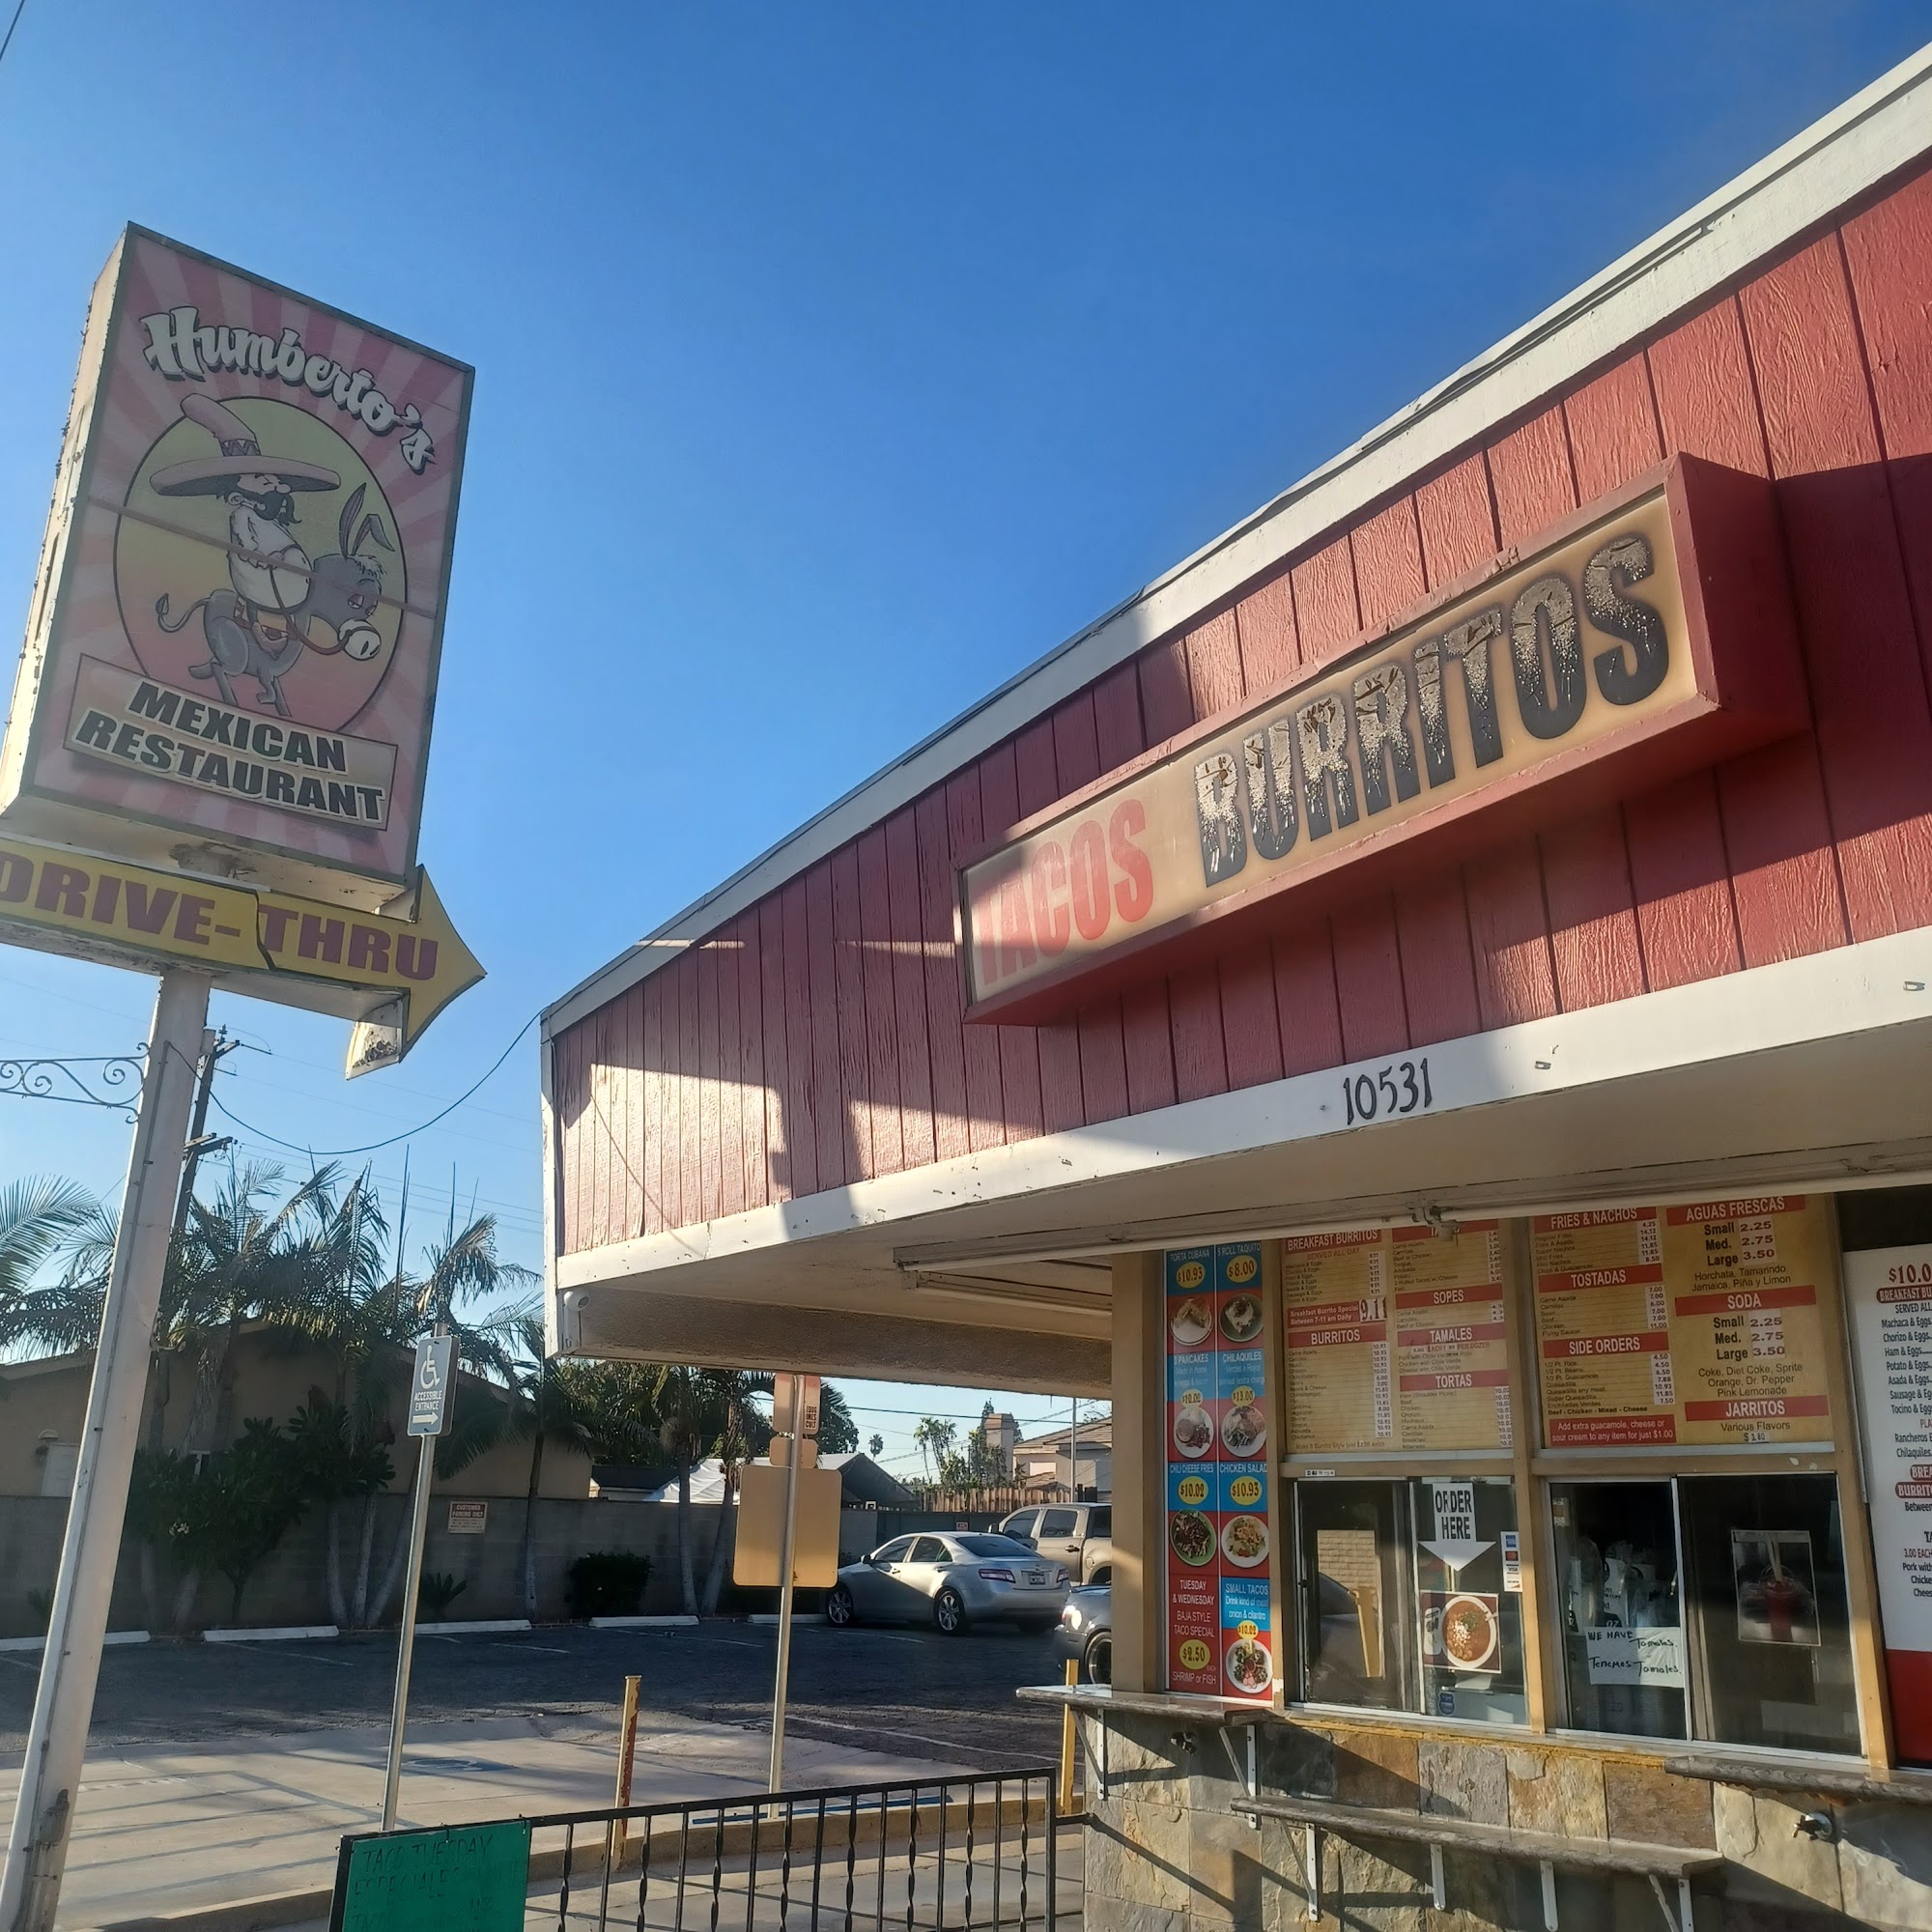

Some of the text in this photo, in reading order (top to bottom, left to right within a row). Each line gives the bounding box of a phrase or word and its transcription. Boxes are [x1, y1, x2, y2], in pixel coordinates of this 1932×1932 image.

[139, 306, 436, 474] Humberto's
[1194, 535, 1668, 888] BURRITOS
[129, 680, 348, 773] MEXICAN
[75, 712, 384, 822] RESTAURANT
[1343, 1058, 1433, 1125] 10531
[1686, 1196, 1785, 1221] AGUAS FRESCAS
[1551, 1207, 1638, 1230] FRIES & NACHOS
[1704, 1221, 1772, 1236] Small 2.25
[1288, 1229, 1378, 1252] BREAKFAST BURRITOS
[1706, 1235, 1774, 1251] Med. 2.75
[1170, 1249, 1209, 1263] TORTA CUBANA
[1222, 1246, 1236, 1256] ROLL
[1307, 1251, 1332, 1261] SERVED
[1348, 1247, 1360, 1256] DAY
[1707, 1249, 1775, 1267] Large 3.50
[1177, 1266, 1204, 1283] $10.93
[1228, 1260, 1254, 1278] $8.00
[1694, 1264, 1786, 1282] Horchata, Tamarindo
[1571, 1269, 1627, 1288] TOSTADAS
[1692, 1274, 1791, 1293] Jamaica, Piña Limon
[1434, 1290, 1464, 1305] SOPES
[1727, 1293, 1762, 1309] SODA
[1879, 1288, 1920, 1302] BREAKFAST
[1290, 1304, 1358, 1318] Breakfast Burrito Special
[1895, 1301, 1932, 1314] SERVED ALL
[1291, 1318, 1314, 1326] Between
[1337, 1314, 1351, 1322] Daily
[1714, 1316, 1782, 1329] Small 2.25
[1881, 1319, 1909, 1328] Machaca
[1910, 1318, 1916, 1326] &
[1311, 1329, 1360, 1345] BURRITOS
[1430, 1327, 1472, 1343] TAMALES
[1715, 1331, 1784, 1345] Med. 2.75
[1883, 1332, 1907, 1343] Chorizo
[1908, 1332, 1914, 1342] &
[1569, 1337, 1640, 1355] SIDE ORDERS
[1885, 1347, 1899, 1357] Ham
[1900, 1347, 1906, 1356] &
[1178, 1353, 1209, 1365] PANCAKES
[1222, 1352, 1262, 1364] CHILAQUILES
[1717, 1346, 1785, 1362] Large 3.50
[1698, 1362, 1803, 1378] Coke, Diet Coke, Sprite
[1887, 1361, 1908, 1371] Potato
[1908, 1361, 1914, 1370] &
[1435, 1374, 1472, 1388] TORTAS
[1708, 1375, 1795, 1389] Orange, Dr. Pepper
[1889, 1375, 1908, 1385] Asada
[1908, 1376, 1914, 1384] &
[413, 1390, 442, 1402] ACCESSIBLE
[1718, 1385, 1787, 1398] Pink Lemonade
[1889, 1389, 1922, 1401] Sausage &
[415, 1402, 440, 1411] ENTRANCE
[1725, 1400, 1785, 1418] JARRITOS
[1890, 1404, 1918, 1414] Tocino &
[1558, 1422, 1570, 1431] Add
[1573, 1422, 1589, 1431] extra
[1590, 1420, 1629, 1432] guacamole,
[1631, 1420, 1655, 1429] cheese
[1720, 1420, 1791, 1433] Various Flavors
[1589, 1433, 1596, 1441] to
[1598, 1433, 1609, 1442] any
[1611, 1432, 1627, 1440] item
[1628, 1431, 1637, 1440] for
[1638, 1431, 1652, 1441] just
[1653, 1430, 1673, 1439] $1.00
[1894, 1432, 1928, 1443] Rancheros
[1896, 1447, 1931, 1459] Chilaquiles
[1170, 1463, 1214, 1474] CHILI CHEESE FRIES
[1220, 1463, 1268, 1474] CHICKEN SALAD
[1435, 1490, 1472, 1514] ORDER
[1441, 1517, 1471, 1540] HERE
[1904, 1548, 1917, 1558] 3.00
[1902, 1562, 1918, 1572] Pork
[1179, 1579, 1207, 1591] TUESDAY
[1225, 1582, 1268, 1595] SMALL TACOS
[1172, 1593, 1215, 1606] & WEDNESDAY
[1177, 1610, 1210, 1623] BAJA STYLE
[1174, 1624, 1215, 1637] TACO SPECIAL
[1587, 1631, 1604, 1641] WE
[1606, 1630, 1634, 1639] HAVE
[1182, 1646, 1206, 1662] $2.50
[1589, 1656, 1632, 1669] Tenemos
[1172, 1671, 1216, 1685] SHRIMP FISH
[363, 1834, 493, 1873] TACO TUESDAY
